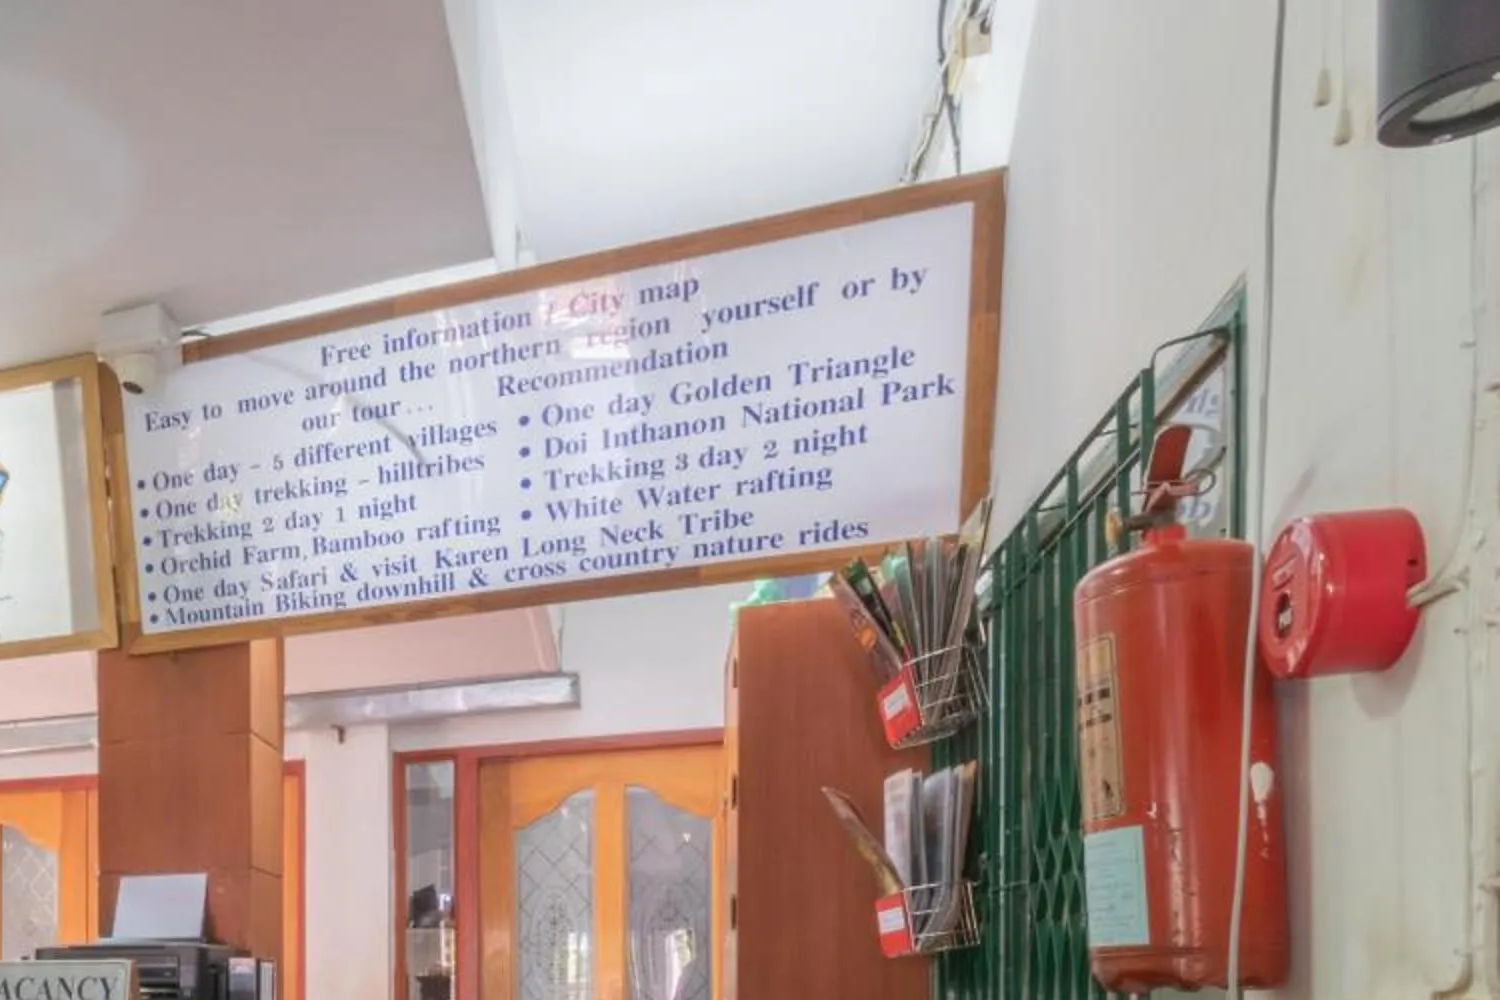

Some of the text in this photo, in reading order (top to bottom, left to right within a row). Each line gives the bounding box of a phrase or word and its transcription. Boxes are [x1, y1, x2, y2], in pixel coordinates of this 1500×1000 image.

[145, 266, 927, 434] Easy to move around the northern region yourself or by
[321, 342, 371, 367] Free
[382, 310, 532, 355] information
[568, 291, 624, 319] City
[639, 277, 699, 307] map
[496, 341, 728, 398] Recommendation
[542, 346, 915, 427] One day Golden Triangle
[301, 412, 339, 432] our
[545, 373, 954, 459] Doi Inthanon National Park
[153, 471, 194, 491] One
[204, 462, 240, 484] day
[273, 455, 284, 471] 5
[294, 436, 391, 469] different
[407, 418, 497, 450] villages
[156, 499, 196, 521] One
[207, 491, 241, 513] day
[254, 478, 347, 505] trekking
[378, 452, 485, 485] hilltribes
[544, 423, 868, 492] Trekking 3 day 2 night
[159, 494, 416, 548] Trekking 2 day 1 night
[546, 464, 833, 526] White Water rafting
[161, 550, 231, 577] Orchid
[312, 528, 404, 555] Bamboo
[416, 513, 501, 543] rafting
[164, 507, 754, 604] One day Safari & visit Karen Long Neck Tribe
[164, 517, 868, 626] Mountain Biking downhill & cross country nature rides
